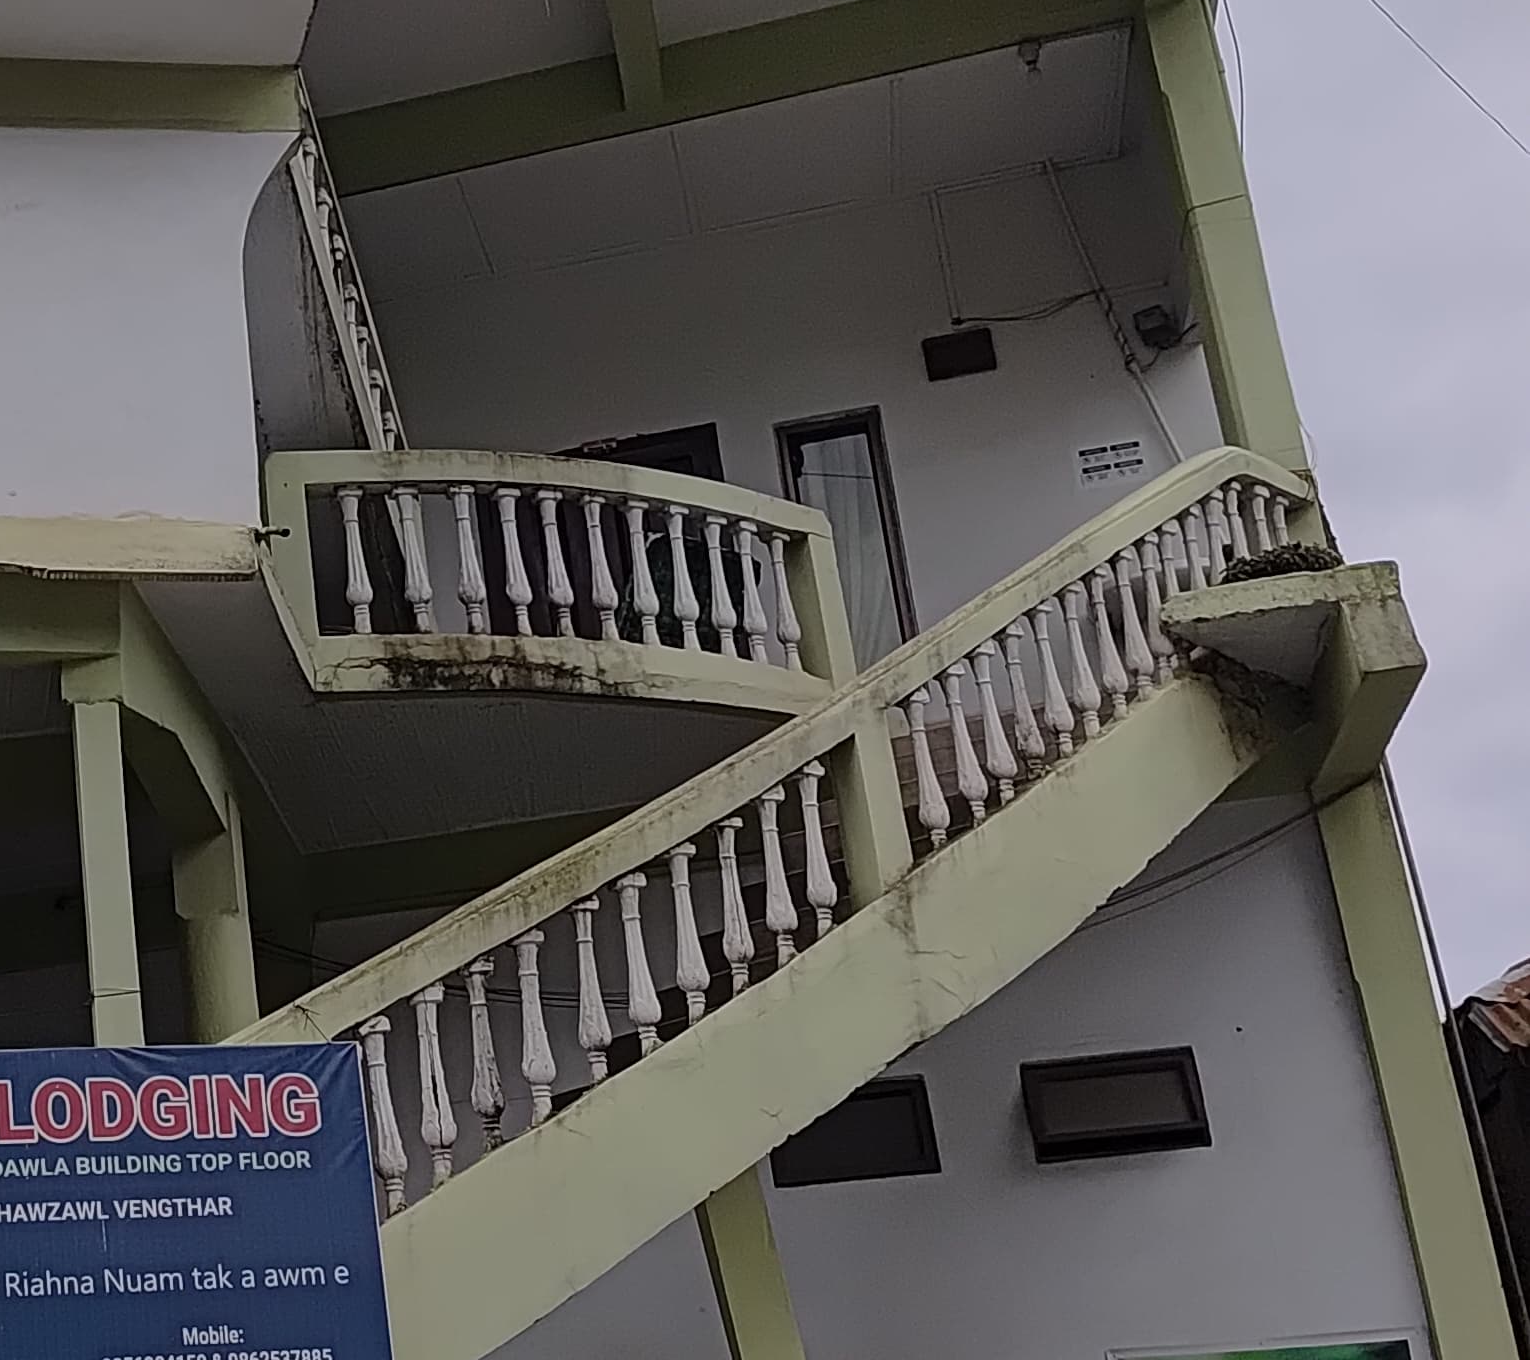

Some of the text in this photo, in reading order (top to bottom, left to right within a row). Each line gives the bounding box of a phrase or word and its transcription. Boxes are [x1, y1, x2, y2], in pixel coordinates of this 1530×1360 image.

[76, 1154, 182, 1175] BUILDING
[186, 1153, 233, 1172] TOP
[239, 1150, 312, 1170] FLOOR
[113, 1197, 234, 1219] VENGTHAR
[5, 1264, 350, 1297] Riahna Nuam tak a awm e
[182, 1326, 245, 1346] Mobile:
